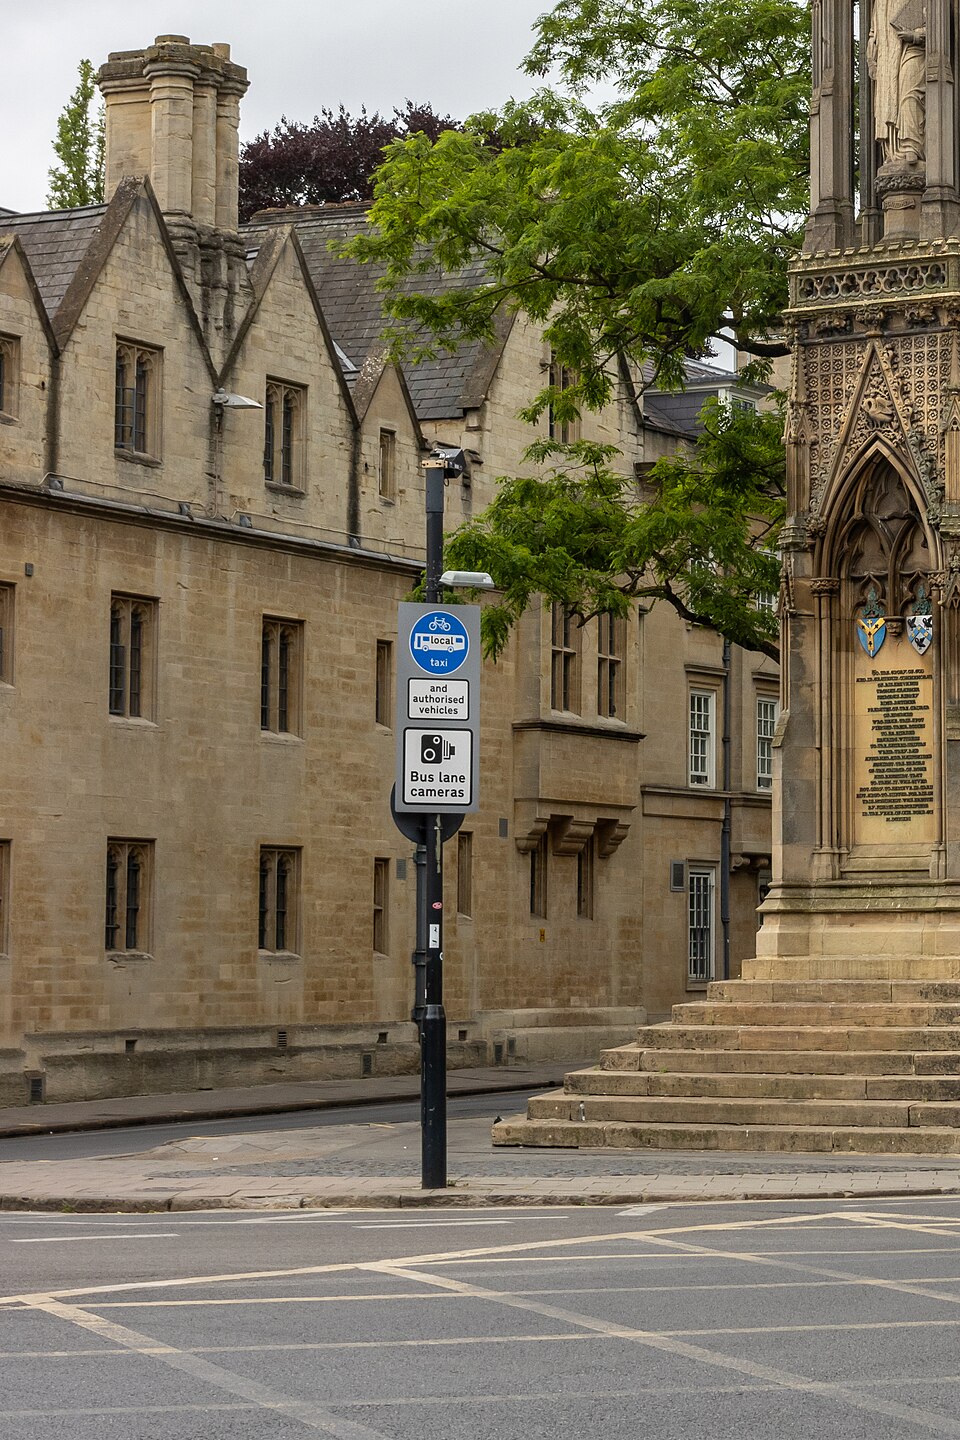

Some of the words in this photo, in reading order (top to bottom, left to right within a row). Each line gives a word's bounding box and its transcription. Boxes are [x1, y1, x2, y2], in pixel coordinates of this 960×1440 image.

[430, 635, 454, 645] local
[430, 658, 448, 667] taxi
[430, 684, 448, 693] and
[412, 695, 464, 704] authorised
[419, 706, 458, 714] vehicles
[410, 771, 434, 782] Bus
[439, 771, 466, 783] lane
[410, 788, 464, 798] cameras
